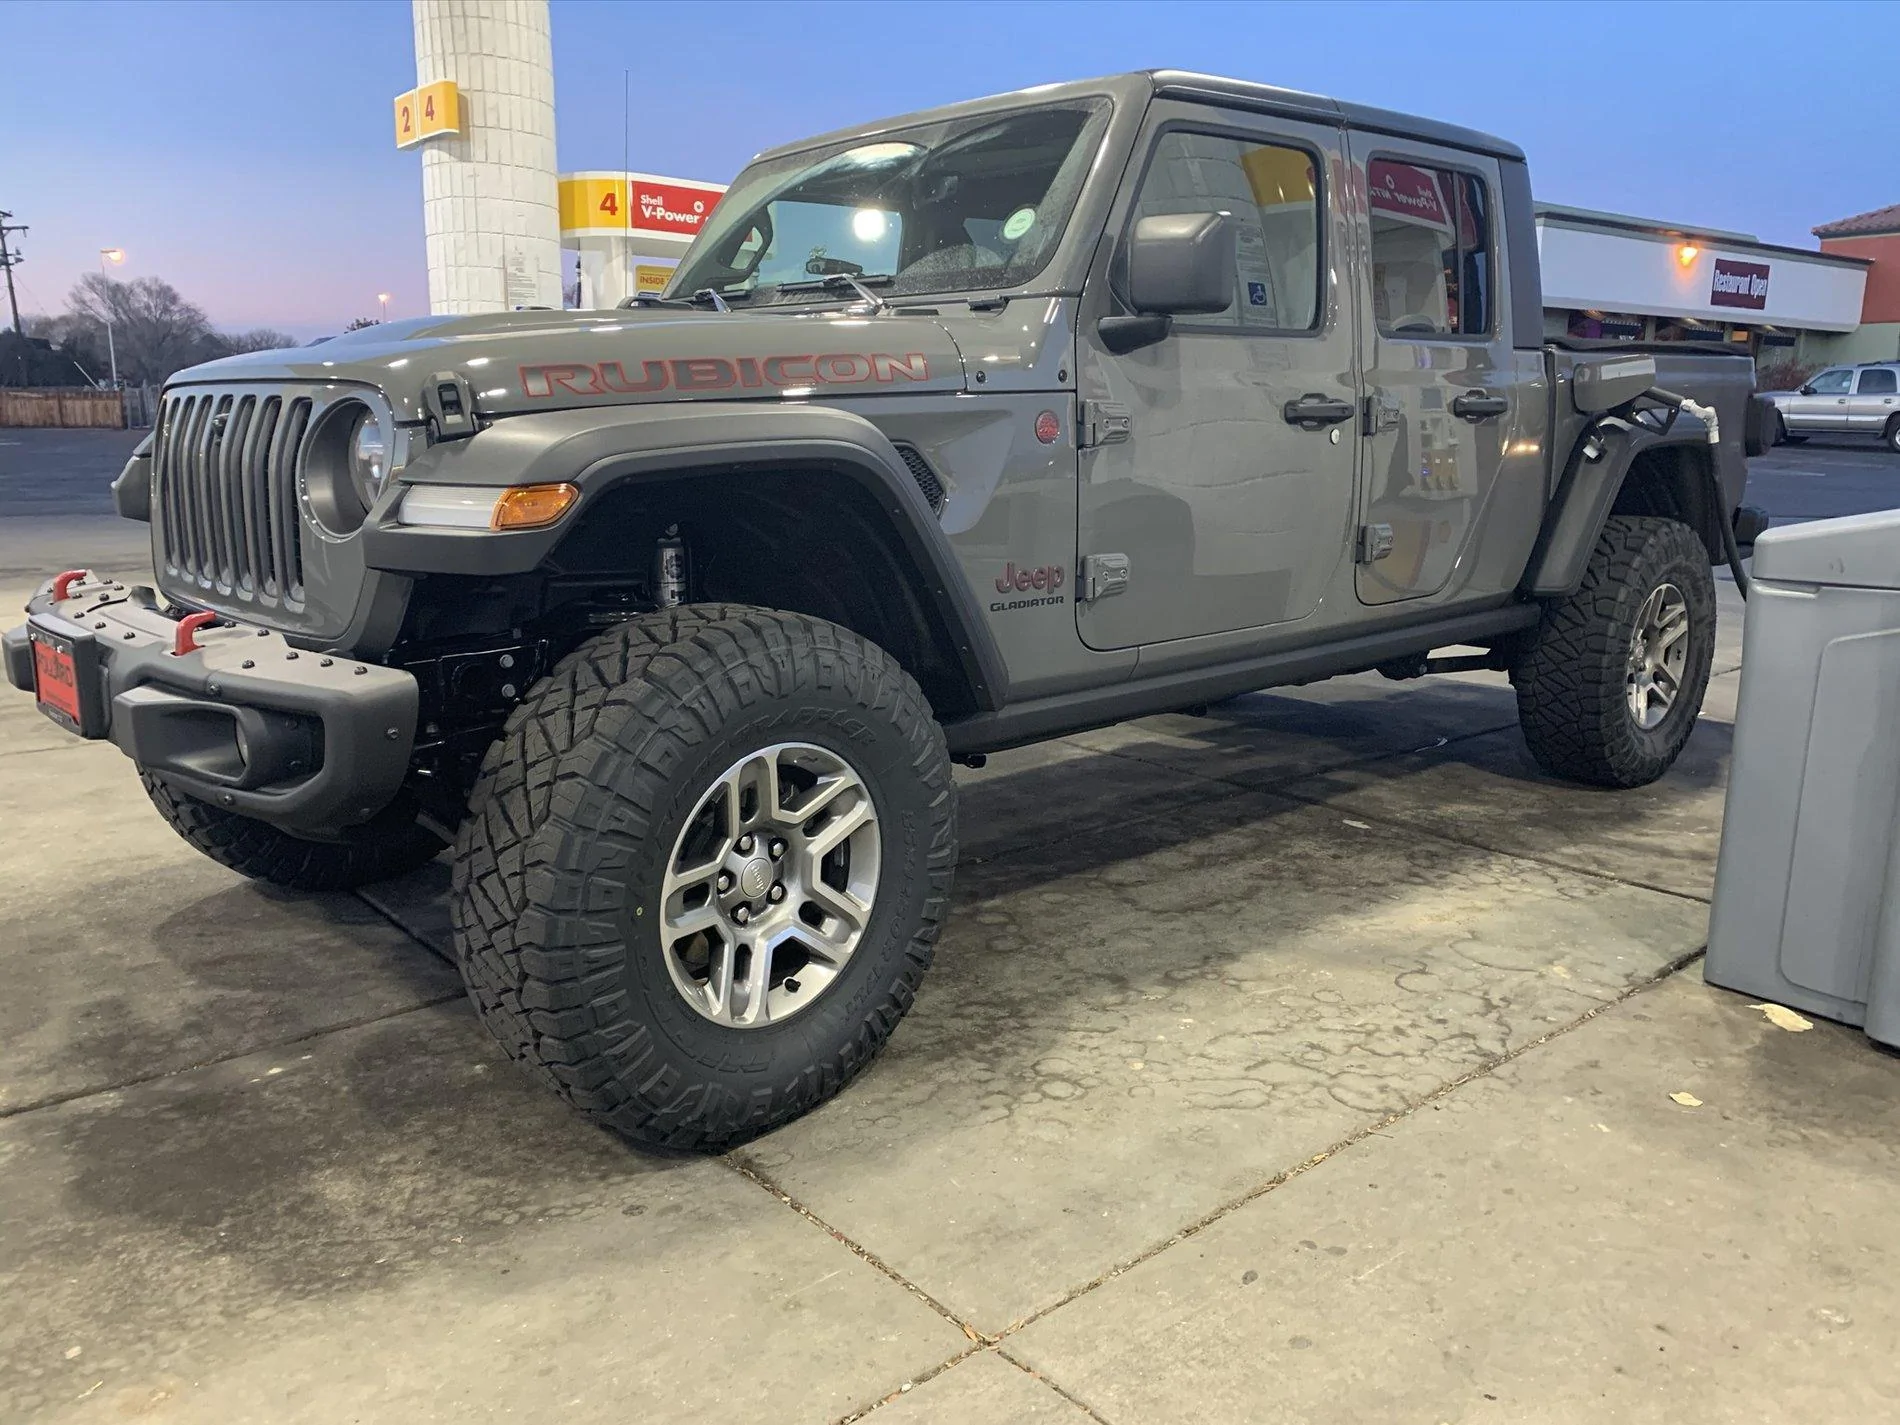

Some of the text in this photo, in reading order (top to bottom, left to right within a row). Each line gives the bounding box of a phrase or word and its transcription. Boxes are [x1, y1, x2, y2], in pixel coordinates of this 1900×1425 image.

[402, 95, 435, 133] 2 4
[600, 193, 618, 216] 4
[640, 194, 663, 206] Shell
[641, 204, 702, 224] V-Power
[640, 275, 665, 285] INSIDE
[1713, 269, 1767, 299] Restaurant Open
[519, 352, 929, 398] RUBICON
[995, 561, 1065, 594] Jeep
[990, 596, 1065, 612] GLADIATOR
